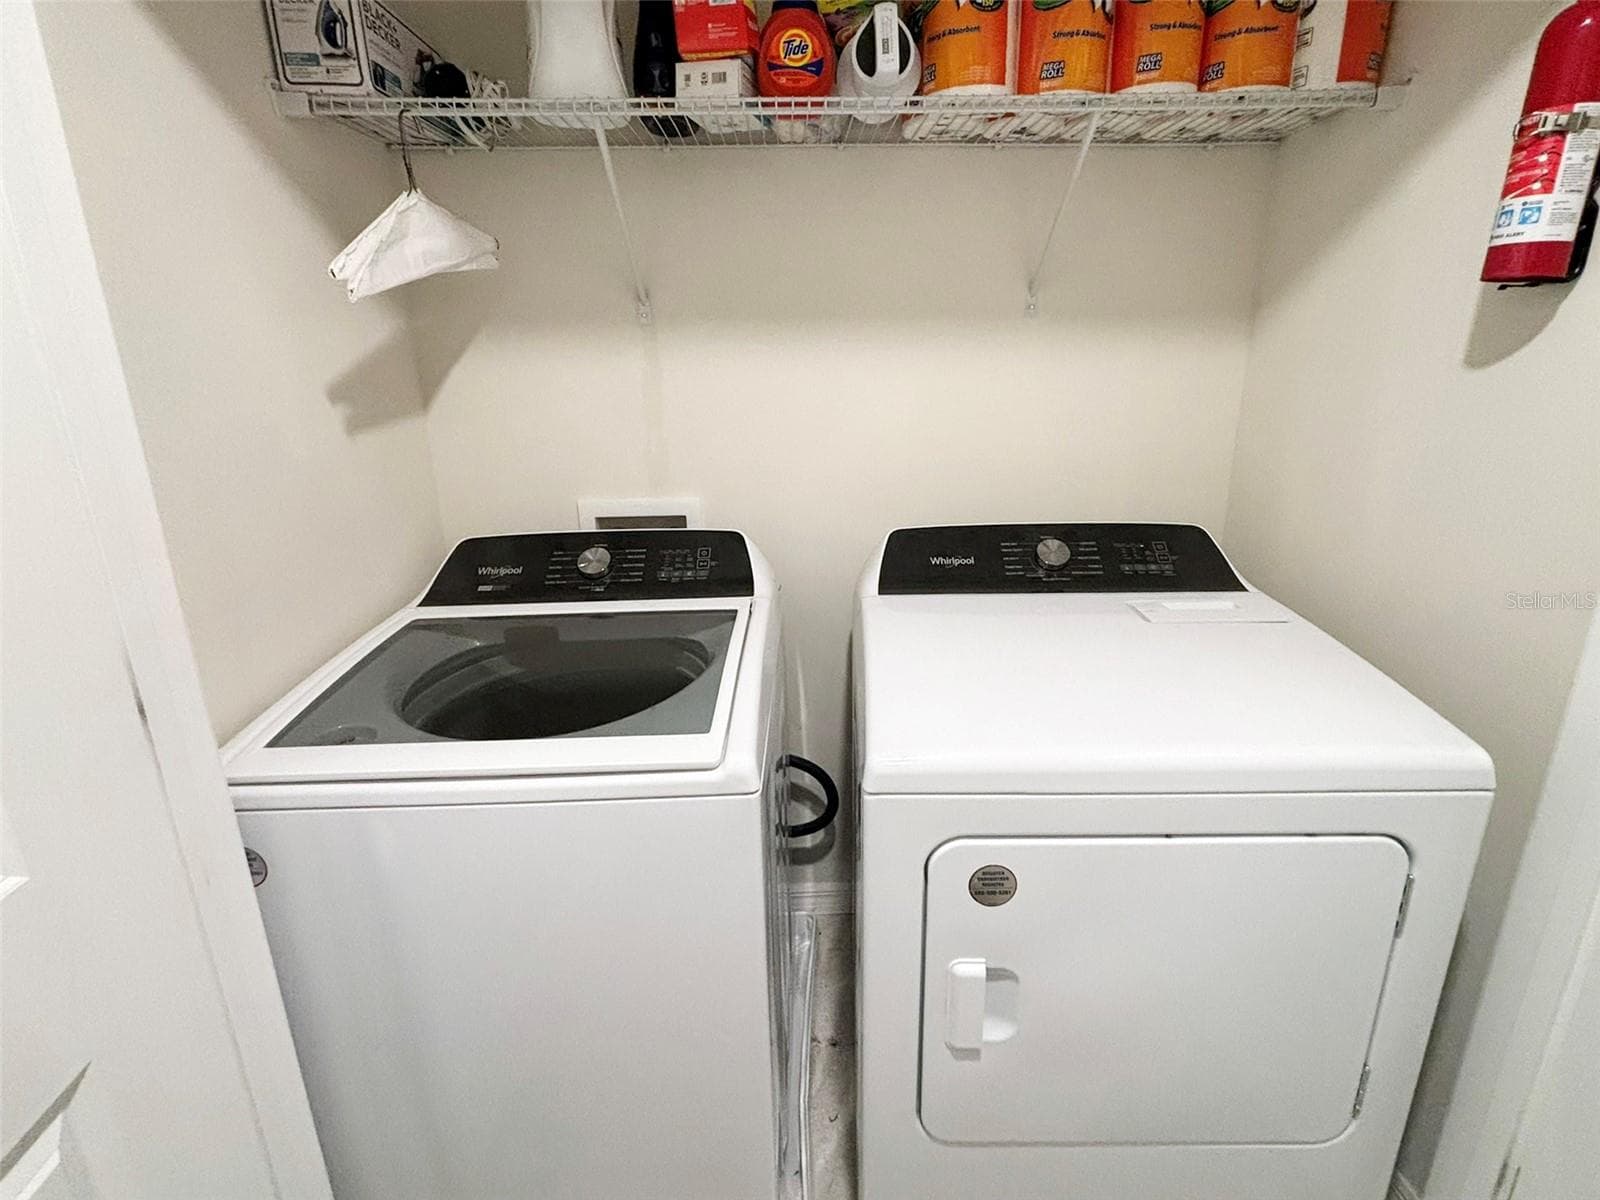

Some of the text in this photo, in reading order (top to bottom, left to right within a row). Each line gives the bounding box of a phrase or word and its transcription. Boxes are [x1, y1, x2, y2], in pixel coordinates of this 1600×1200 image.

[783, 39, 809, 60] Tide
[1140, 54, 1162, 63] MEGA
[1043, 61, 1064, 71] MEGA
[1137, 61, 1162, 72] ROLL
[1040, 68, 1064, 79] ROLL
[929, 556, 975, 567] Whirlpool
[478, 565, 524, 577] Whirlpool
